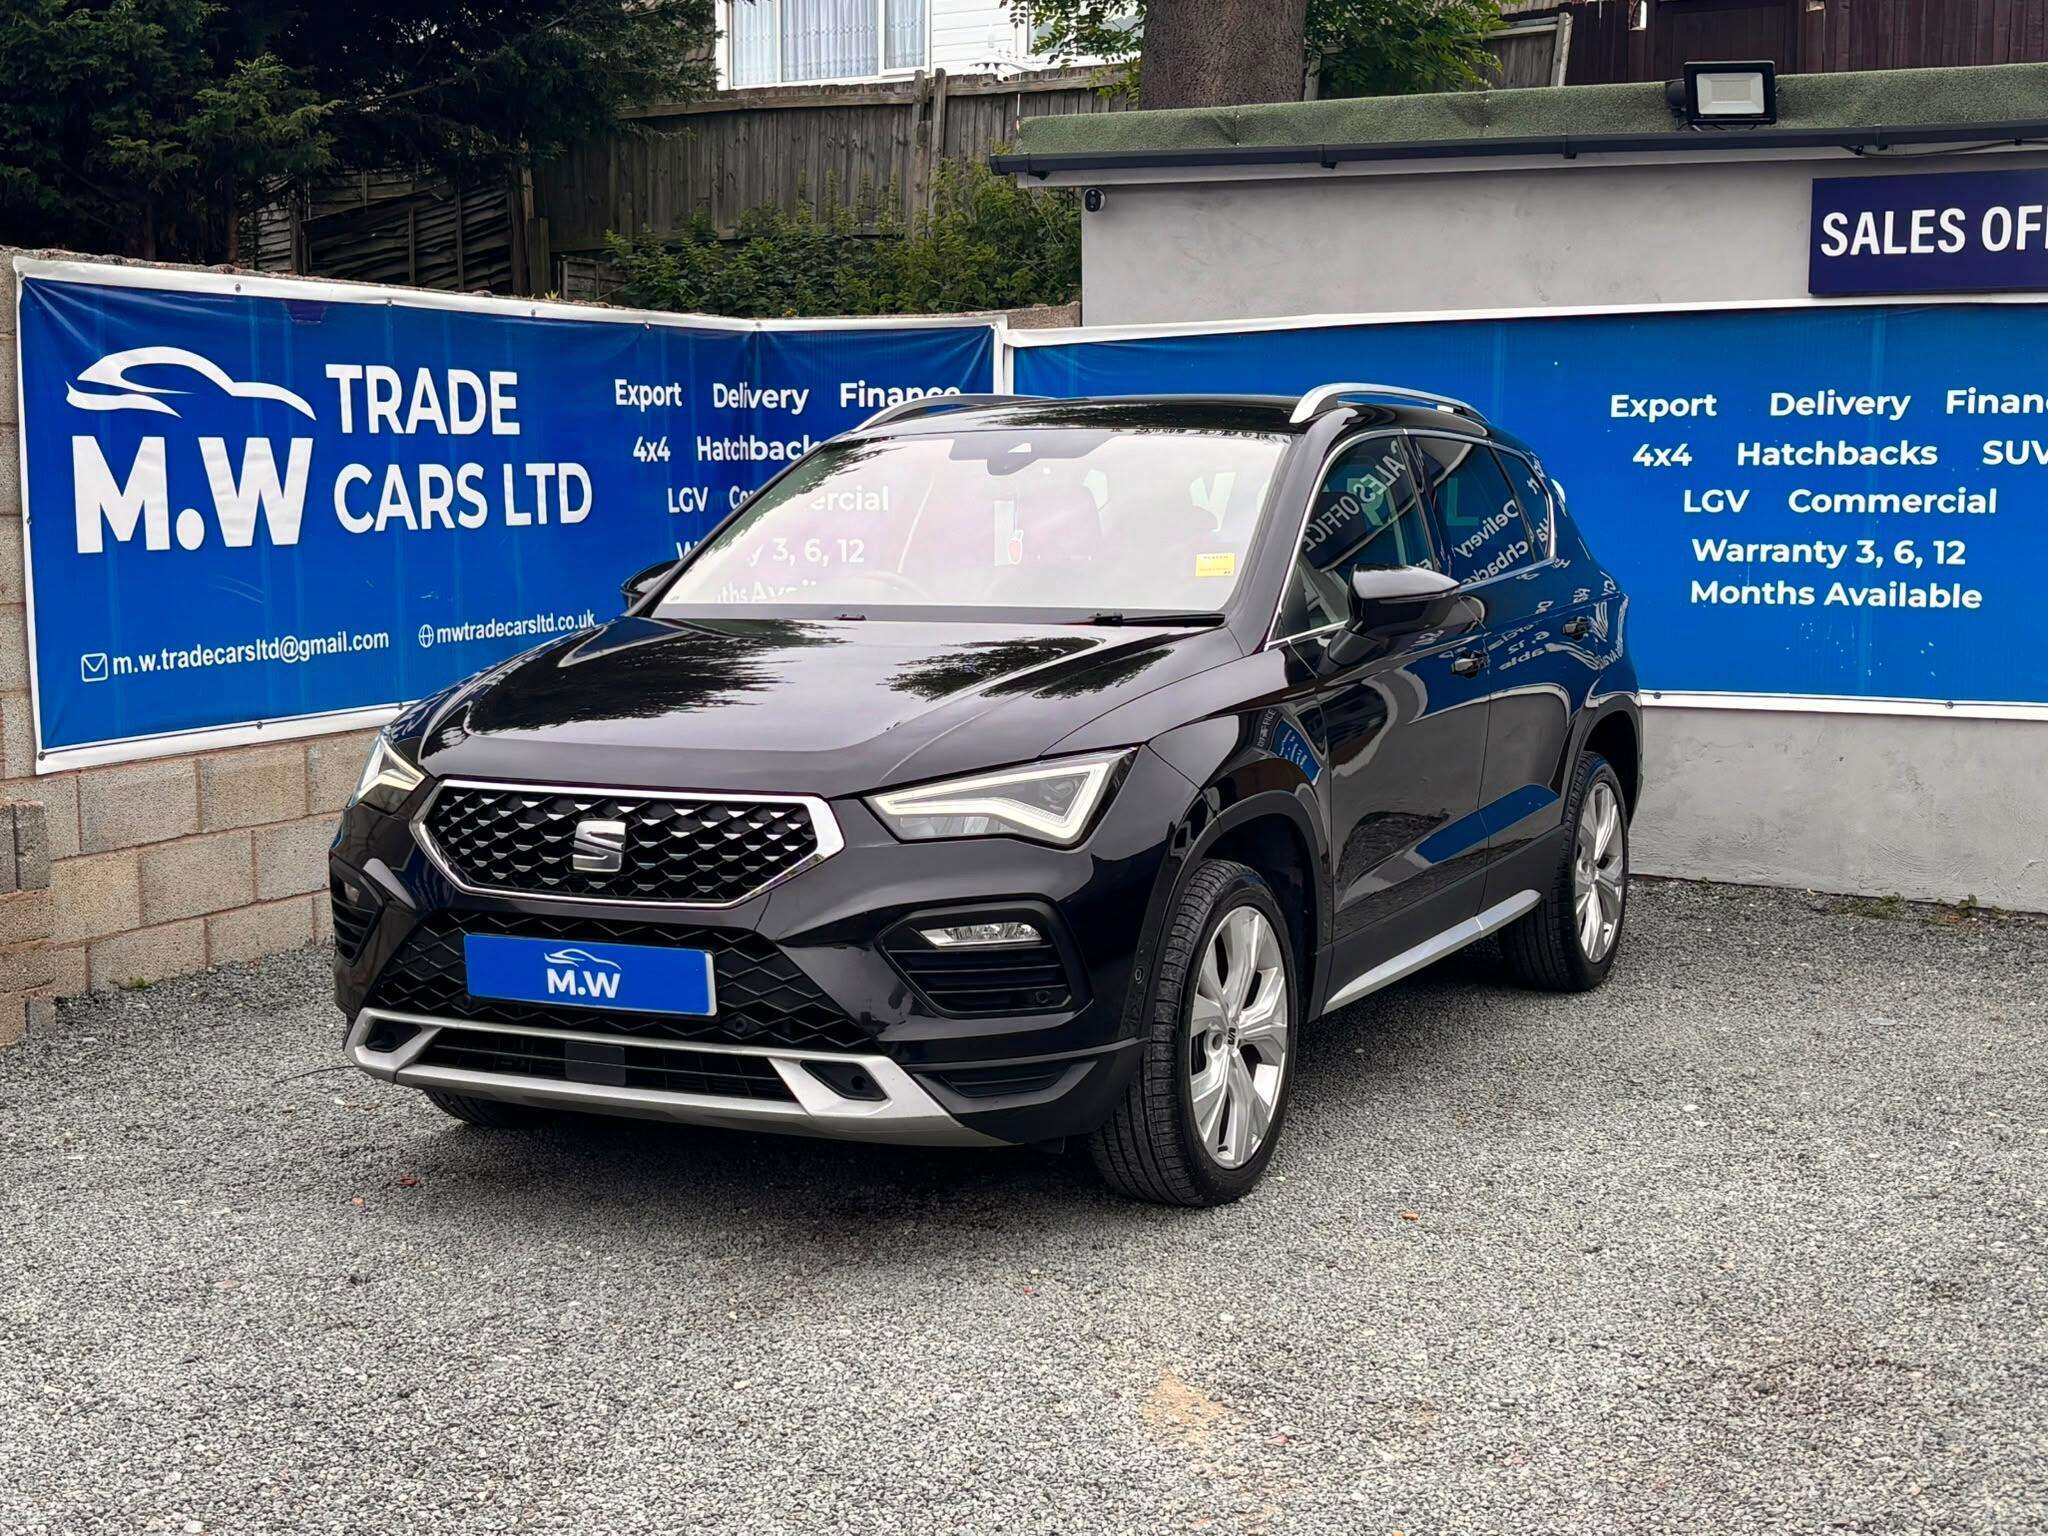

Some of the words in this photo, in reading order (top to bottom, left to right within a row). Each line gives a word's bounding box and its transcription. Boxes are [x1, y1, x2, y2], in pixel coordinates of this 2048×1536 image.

[1820, 207, 1966, 257] SALES
[1981, 204, 2048, 252] OF
[325, 363, 521, 436] TRADE
[614, 378, 683, 413] Export
[712, 382, 810, 416] Delivery
[1610, 394, 1718, 423] Export
[1769, 389, 1911, 421] Delivery
[1945, 386, 2048, 415] Finan
[632, 435, 671, 463] 4x4
[696, 434, 823, 462] Hatchback
[1632, 443, 1694, 467] 4x4
[1737, 440, 1939, 466] Hatchbacks
[71, 434, 315, 555] M.W
[334, 462, 489, 534] CARS
[503, 462, 593, 526] LTD
[667, 485, 710, 514] LGV
[1683, 489, 1751, 513] LGV
[1788, 486, 1998, 514] Commercial
[772, 537, 796, 567] 3,
[804, 538, 829, 567] 6,
[837, 538, 865, 563] 12
[1691, 538, 1848, 569] Warranty
[1855, 540, 1884, 569] 3,
[1893, 540, 1923, 569] 6,
[1932, 540, 1967, 565] 12
[1690, 580, 1816, 606] Months
[1823, 580, 1983, 609] Available
[436, 609, 595, 644] mwtradecarsltd.co.uk
[112, 630, 390, 677] m.w.tradecarsltd@gmail.com
[546, 967, 622, 1000] M.W
